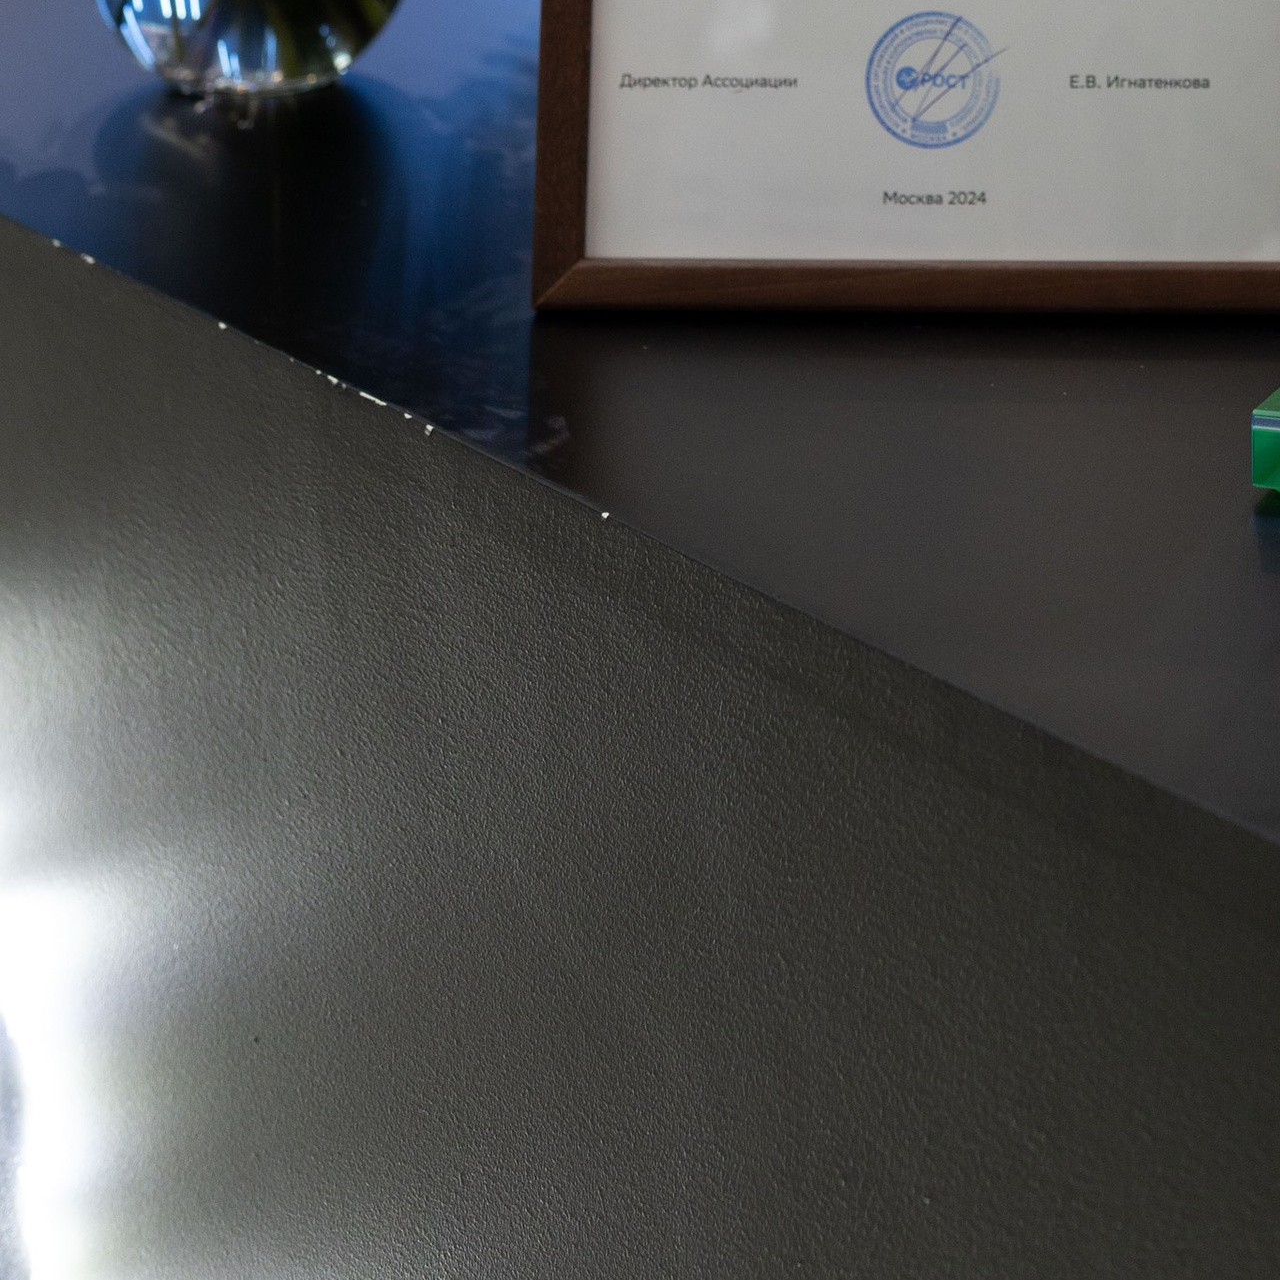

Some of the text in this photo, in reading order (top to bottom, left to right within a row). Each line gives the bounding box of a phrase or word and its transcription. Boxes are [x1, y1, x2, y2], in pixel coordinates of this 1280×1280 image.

[618, 72, 798, 90] Директор Ассоциации
[1069, 74, 1211, 90] Е.В. Игнатенкова
[882, 190, 987, 206] Москва 2024
